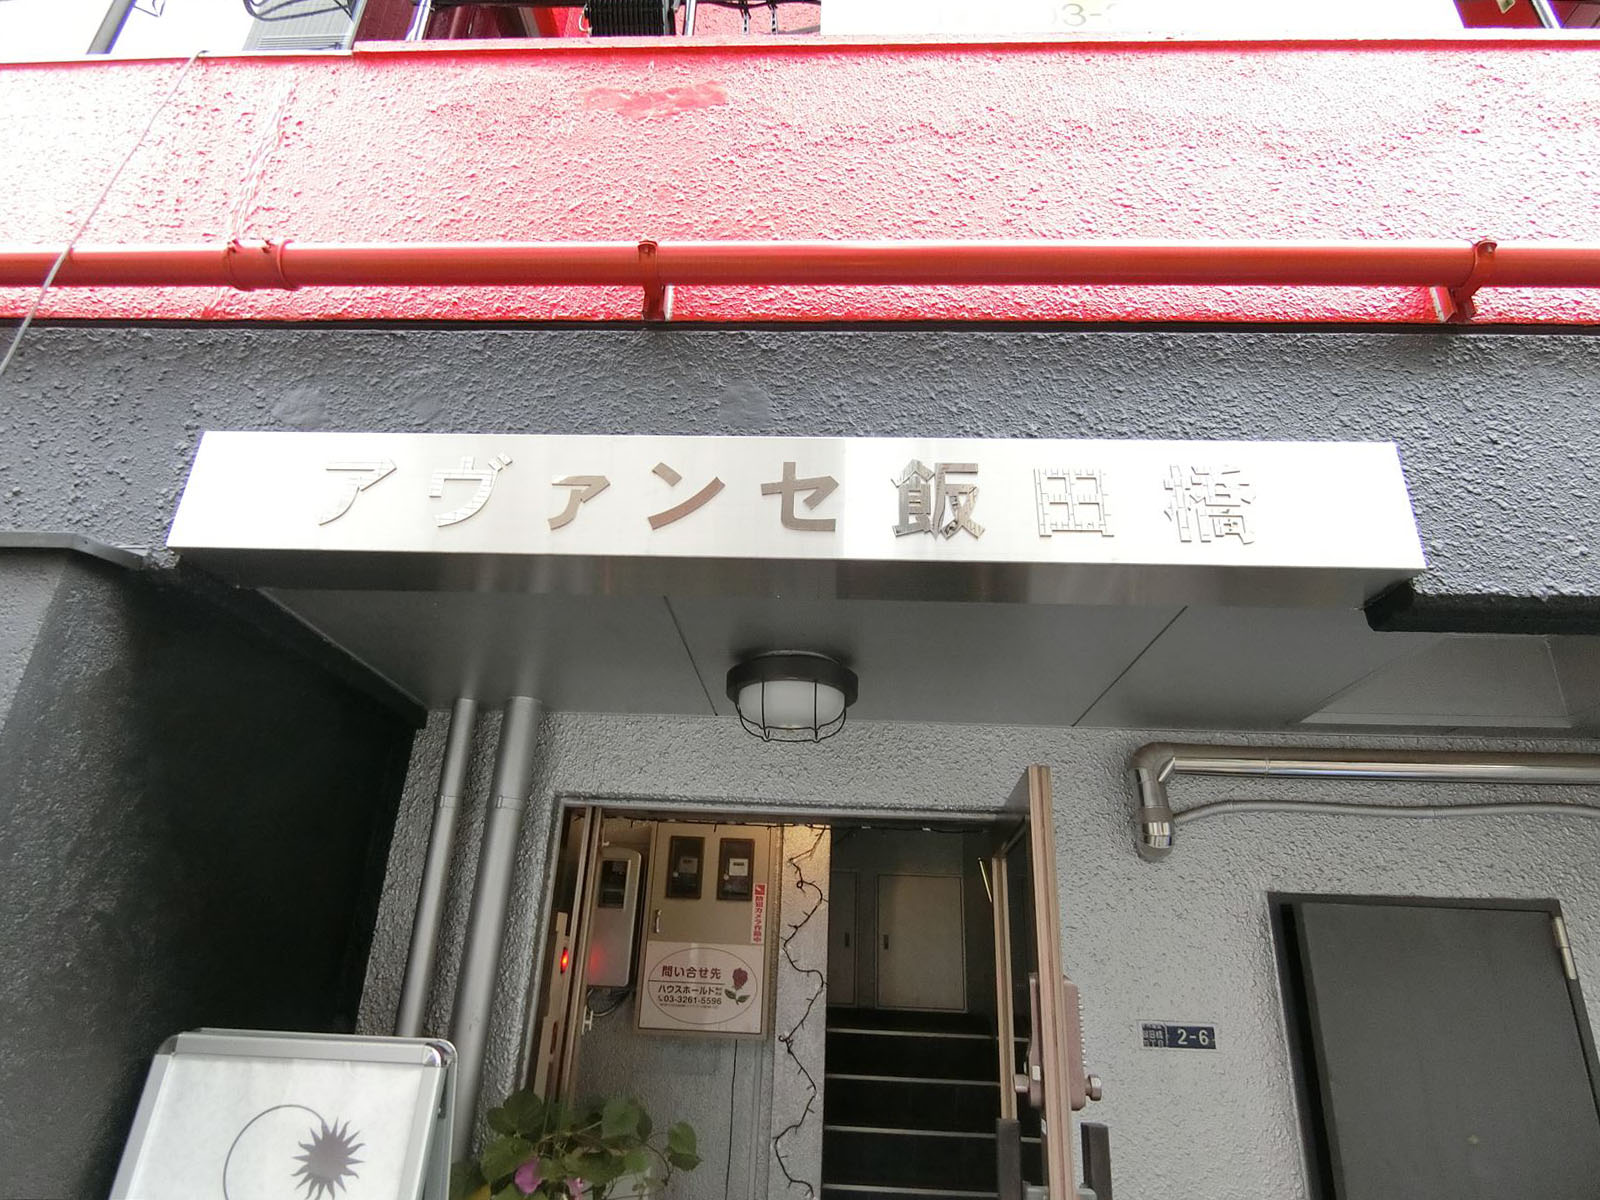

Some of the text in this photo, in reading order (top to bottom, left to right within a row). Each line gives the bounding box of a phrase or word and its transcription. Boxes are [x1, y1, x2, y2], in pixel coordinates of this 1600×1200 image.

[319, 451, 1256, 545] アヴァンセ飯田橋
[661, 965, 722, 980] 問い合せ先
[658, 984, 716, 996] ハウスホールド
[664, 994, 722, 1005] 03-3261-5596
[1176, 1028, 1209, 1046] 2-6
